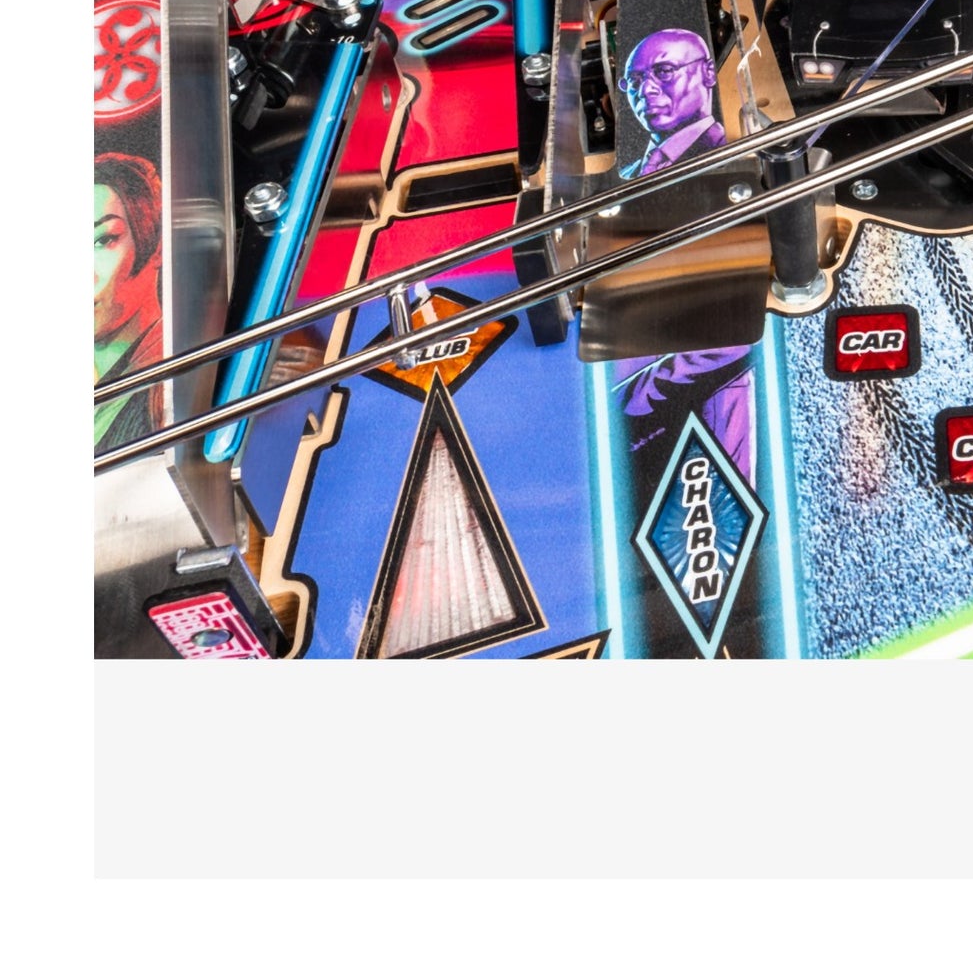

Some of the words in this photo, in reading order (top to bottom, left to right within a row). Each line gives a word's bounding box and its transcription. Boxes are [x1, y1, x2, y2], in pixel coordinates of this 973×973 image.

[415, 338, 468, 363] LUB
[840, 331, 904, 353] CAR
[683, 459, 721, 601] CHARON
